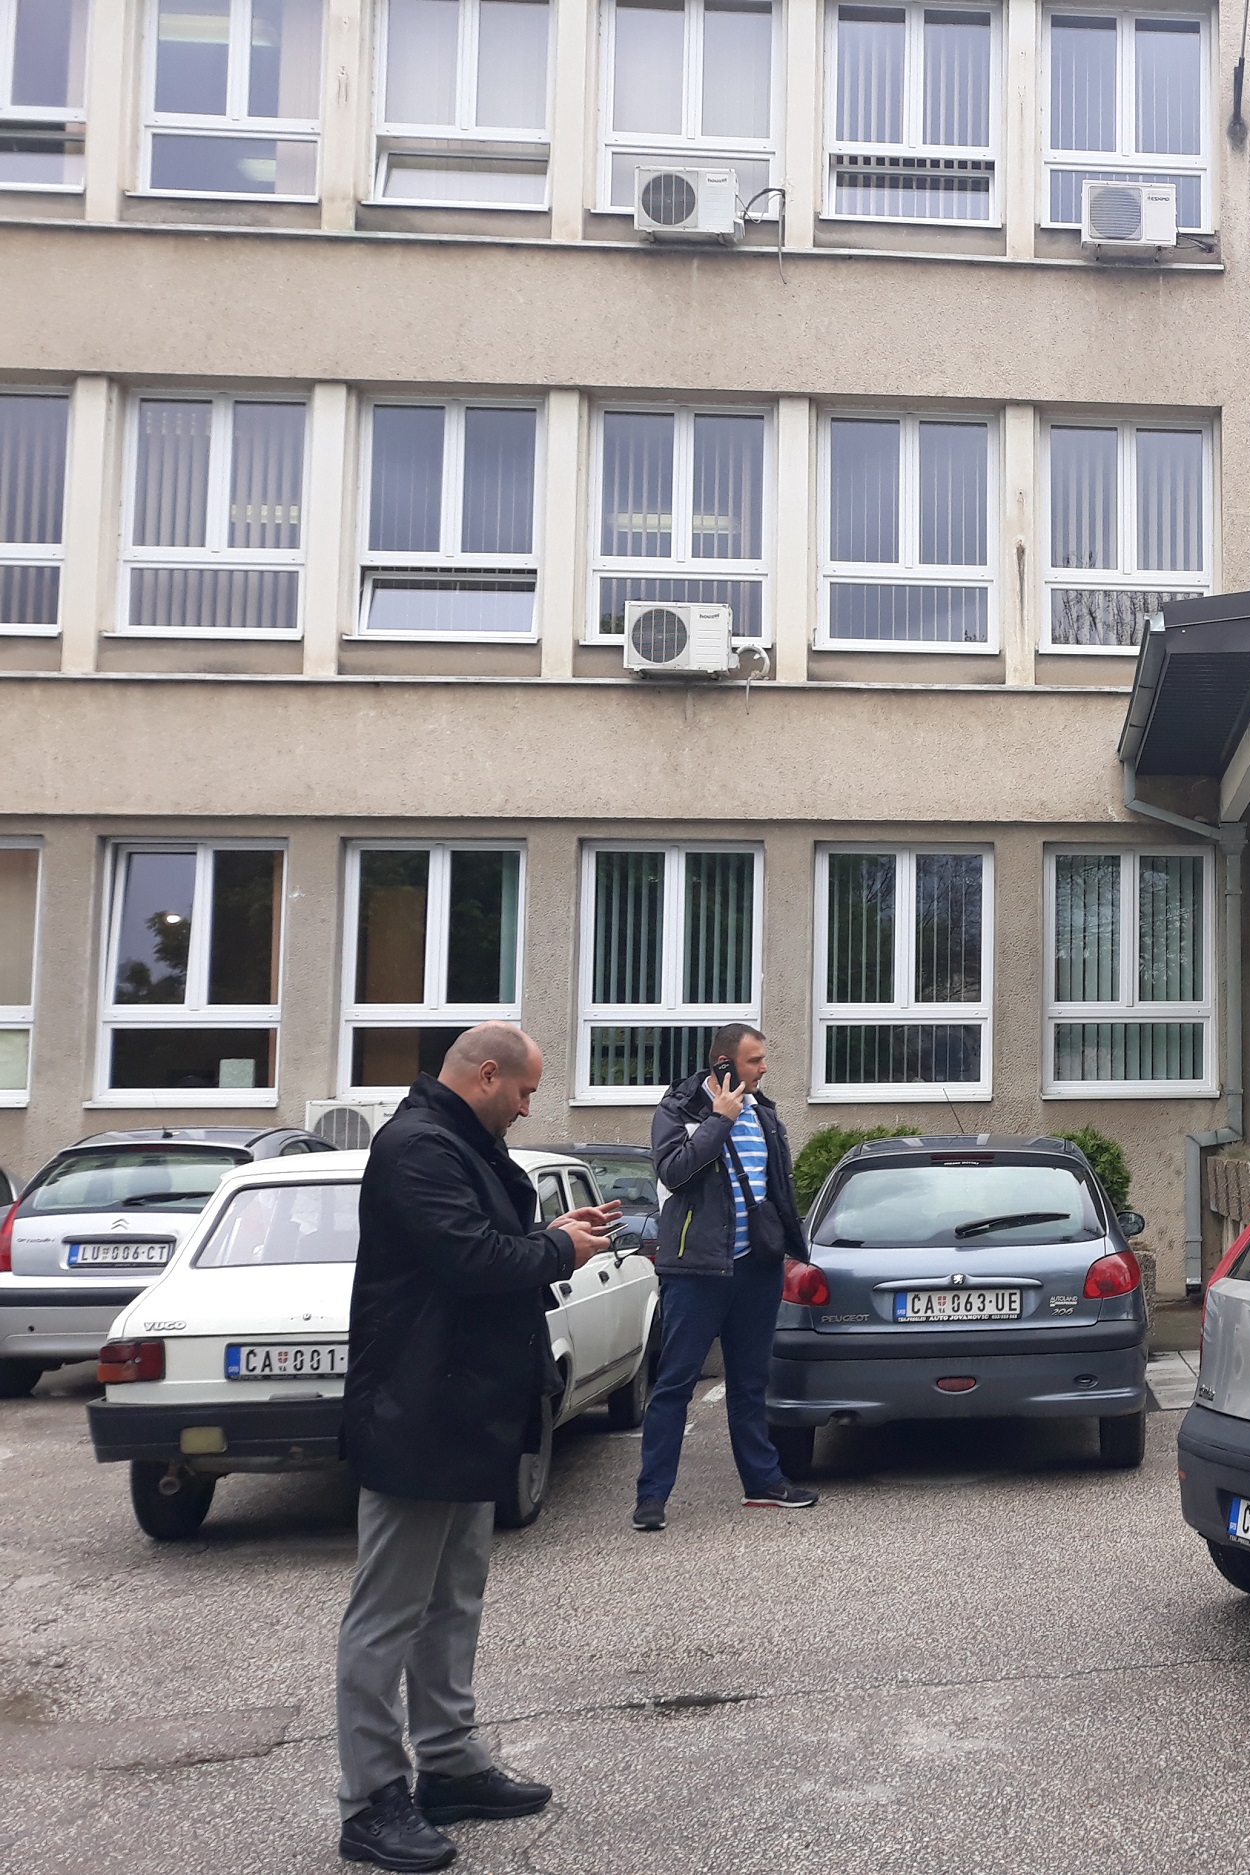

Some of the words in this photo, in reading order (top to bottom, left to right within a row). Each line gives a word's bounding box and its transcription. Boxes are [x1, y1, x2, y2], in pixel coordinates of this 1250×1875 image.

[81, 1246, 102, 1261] LU
[911, 1292, 935, 1315] ČA
[1051, 1307, 1074, 1316] 206
[821, 1314, 870, 1323] PEUGEOT
